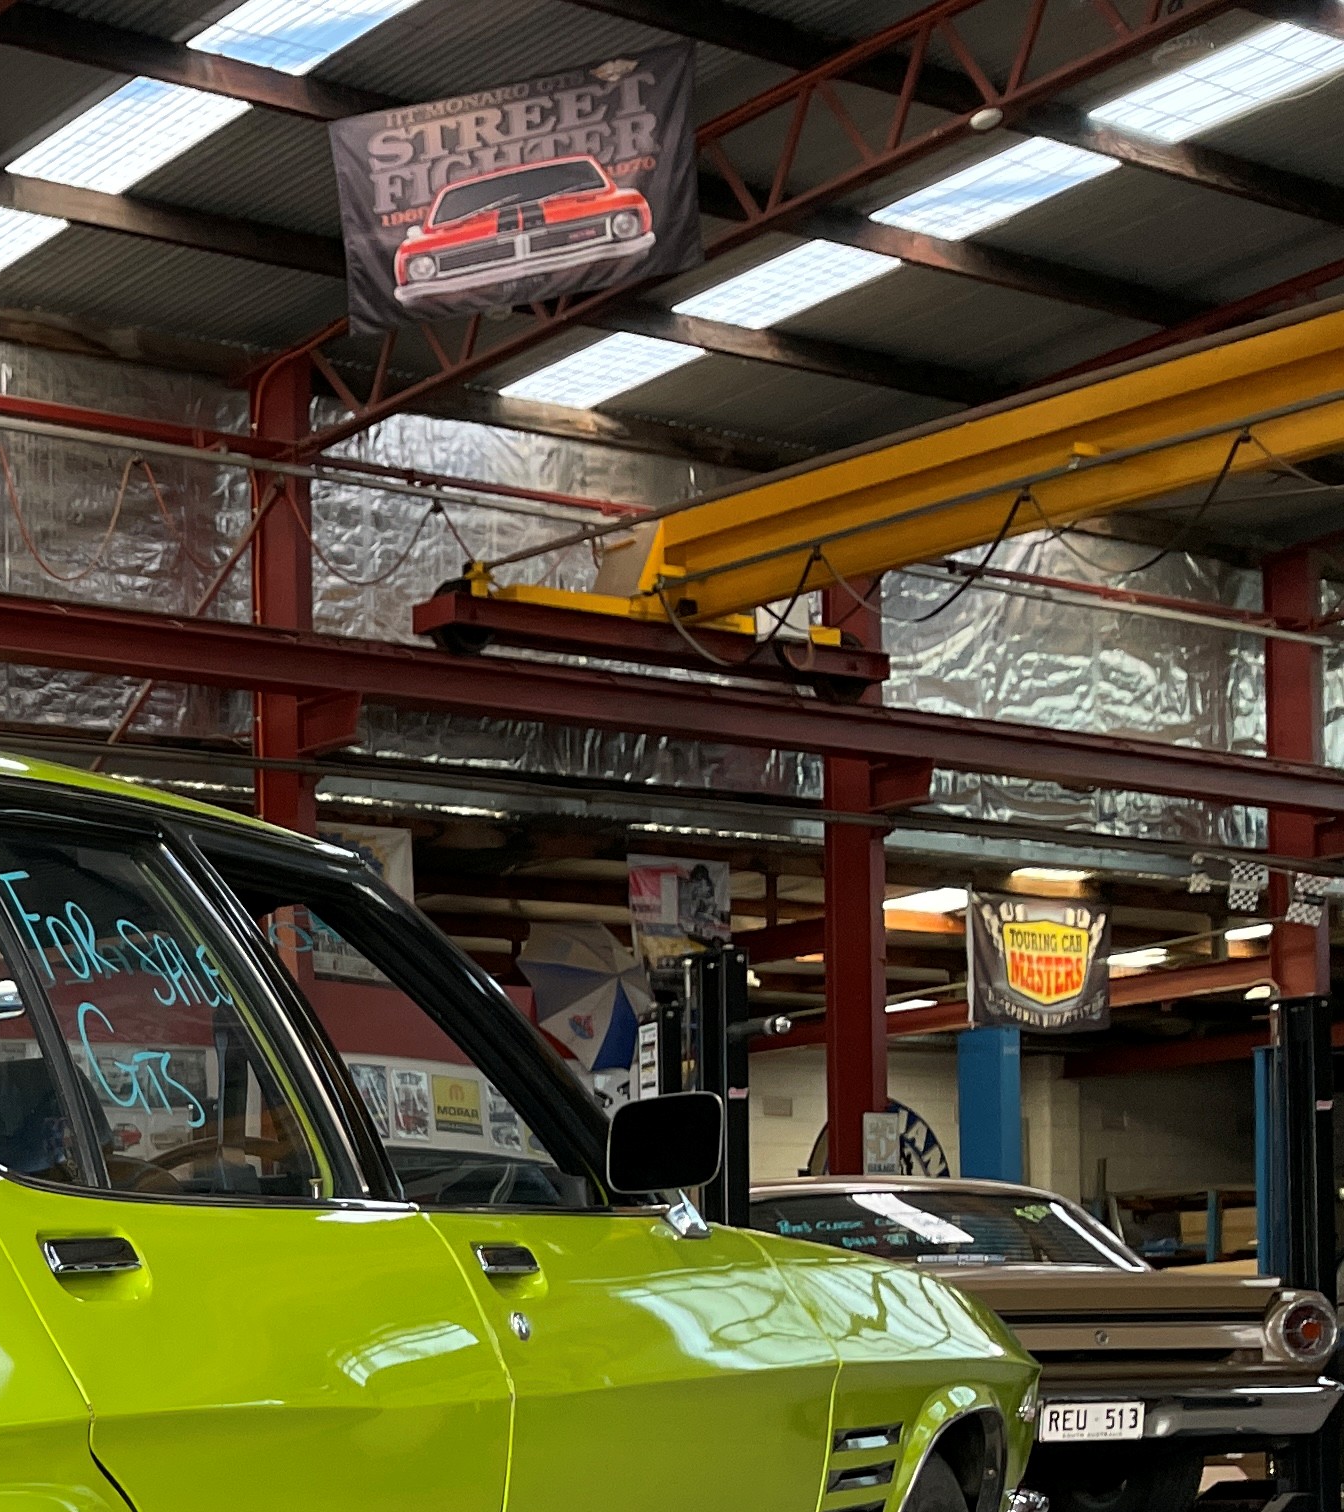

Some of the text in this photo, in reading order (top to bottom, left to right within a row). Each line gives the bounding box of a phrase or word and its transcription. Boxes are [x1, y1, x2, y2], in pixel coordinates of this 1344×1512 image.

[424, 84, 529, 117] MONARO
[368, 71, 656, 172] STREET
[369, 111, 661, 214] FIGHTER
[1010, 928, 1082, 953] TOURING CAR
[116, 918, 234, 1008] SALE
[1009, 952, 1083, 997] MASTERS
[436, 1104, 480, 1120] MOPAR
[1048, 1407, 1139, 1432] REU 513
